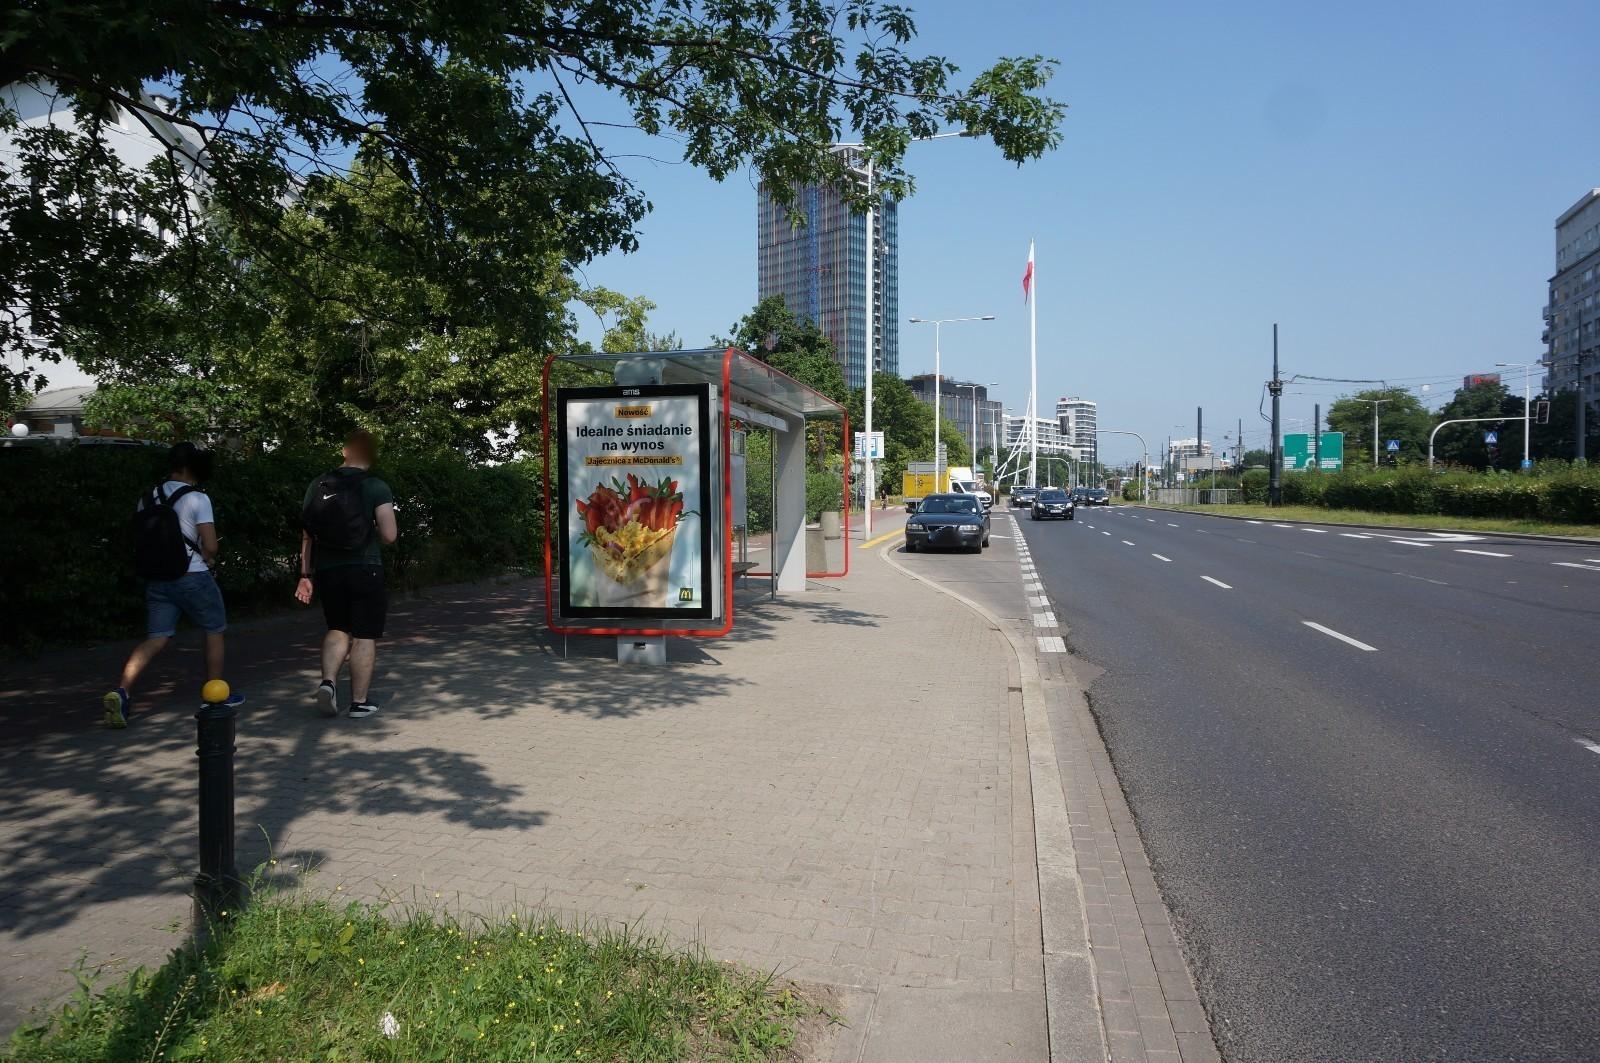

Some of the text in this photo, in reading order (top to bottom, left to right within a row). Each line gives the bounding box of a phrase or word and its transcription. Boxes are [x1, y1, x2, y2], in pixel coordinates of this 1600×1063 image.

[622, 388, 640, 396] ams
[618, 407, 649, 417] Nowość
[576, 424, 692, 437] Idealne śniadanie
[602, 441, 664, 453] na wynos
[587, 457, 626, 467] Jajecznica
